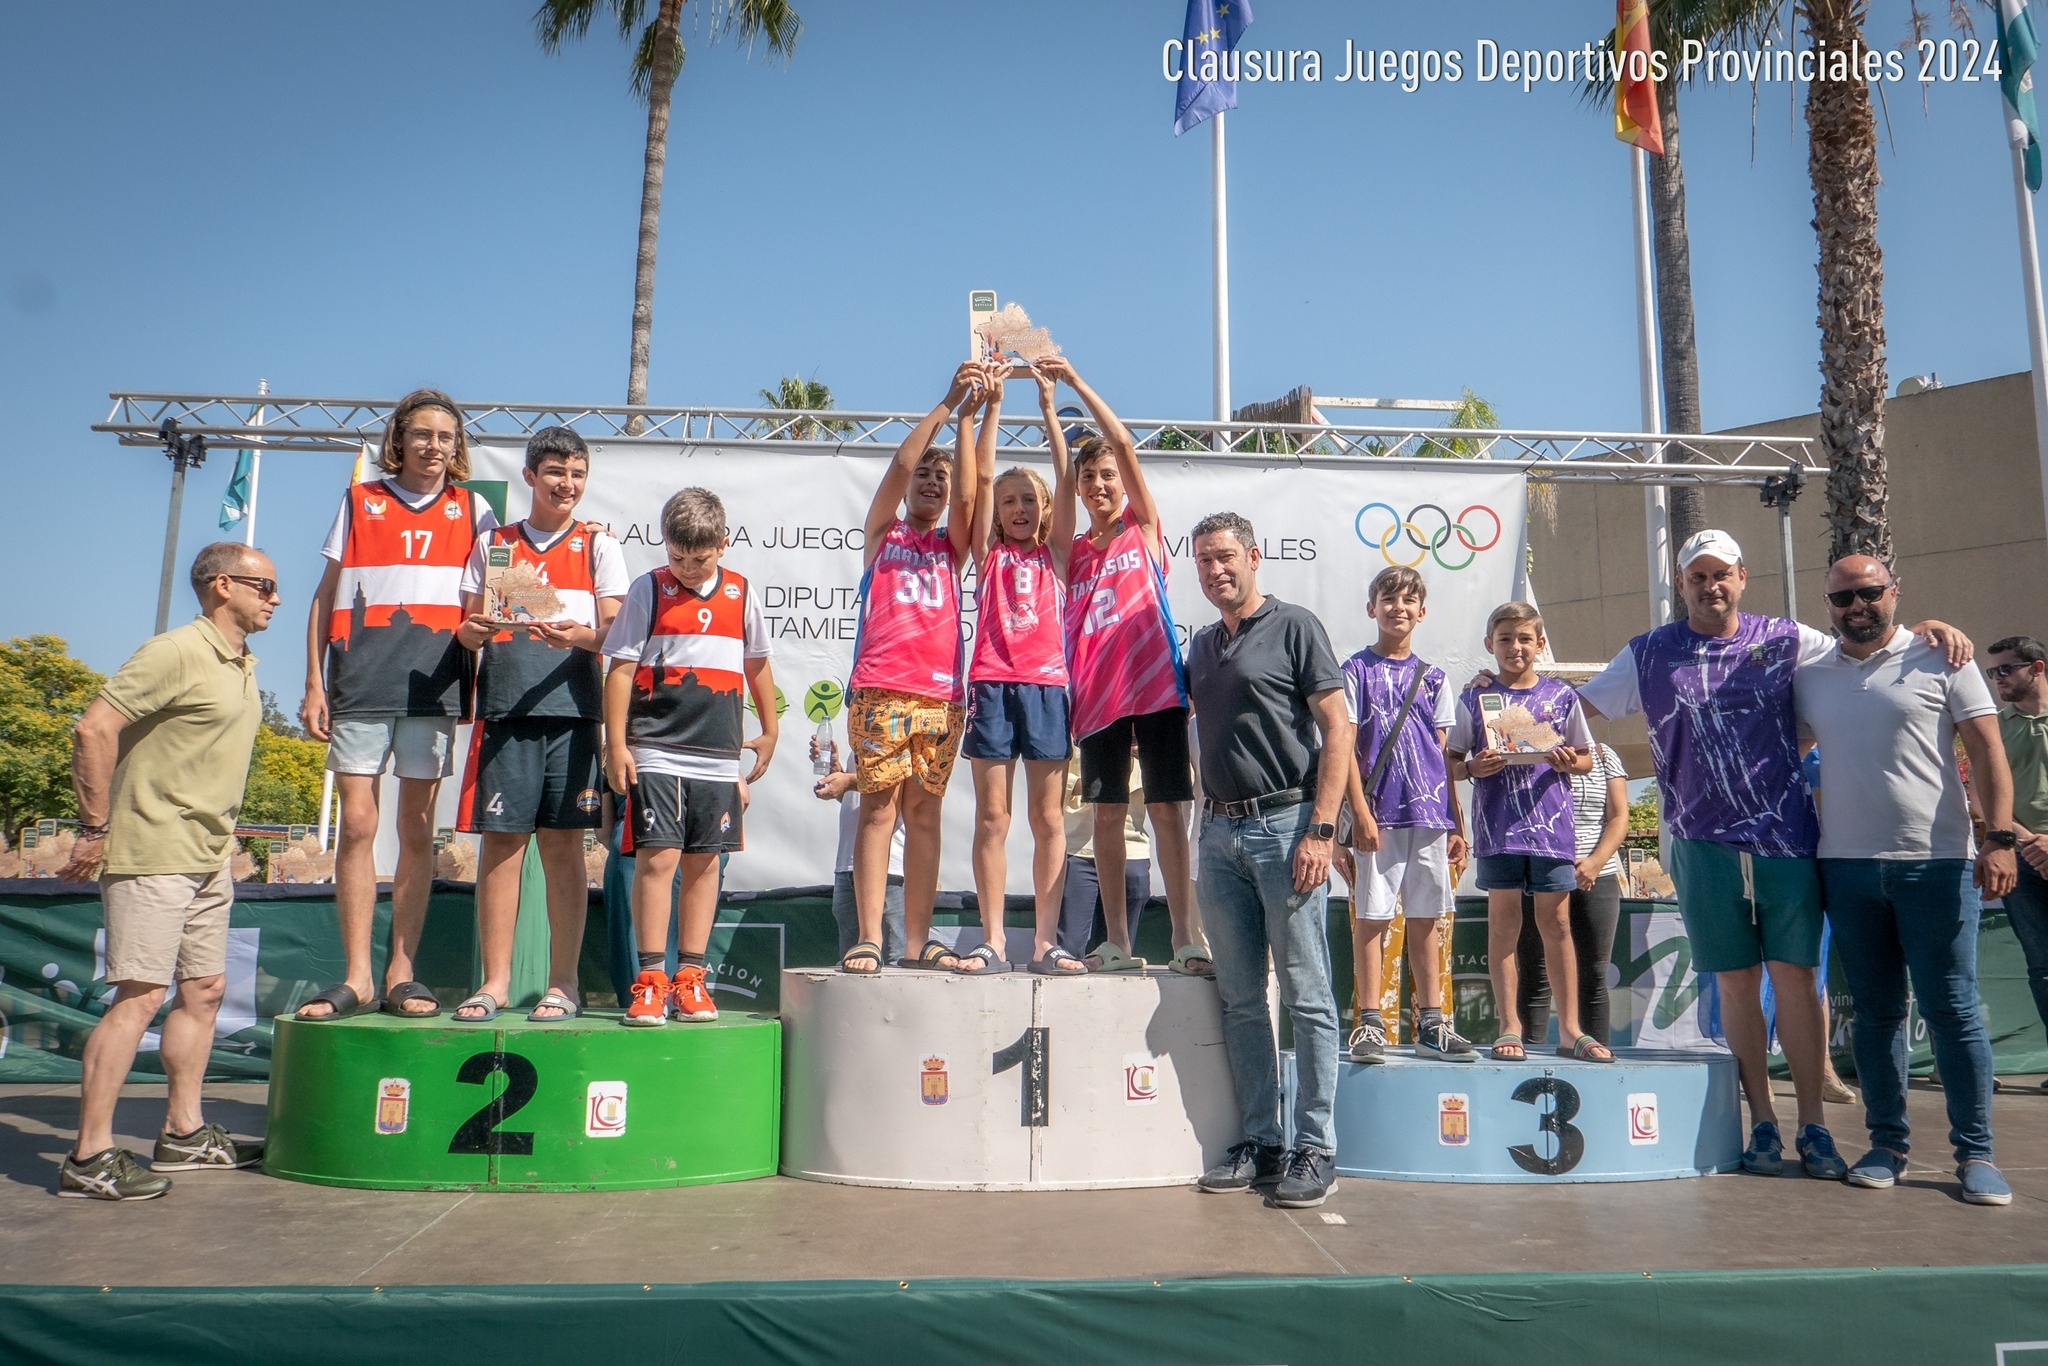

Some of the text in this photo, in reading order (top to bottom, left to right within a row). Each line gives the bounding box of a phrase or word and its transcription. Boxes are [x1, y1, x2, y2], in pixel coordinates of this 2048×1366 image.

[401, 529, 433, 560] 17
[763, 526, 865, 551] JUEGO
[895, 565, 945, 609] 30
[1014, 565, 1033, 595] 8
[697, 608, 713, 633] 9
[486, 792, 504, 816] 4
[642, 808, 657, 831] 9
[705, 962, 763, 988] ACION
[992, 1026, 1051, 1127] 1
[447, 1051, 538, 1156] 2
[1506, 1076, 1585, 1176] 3
